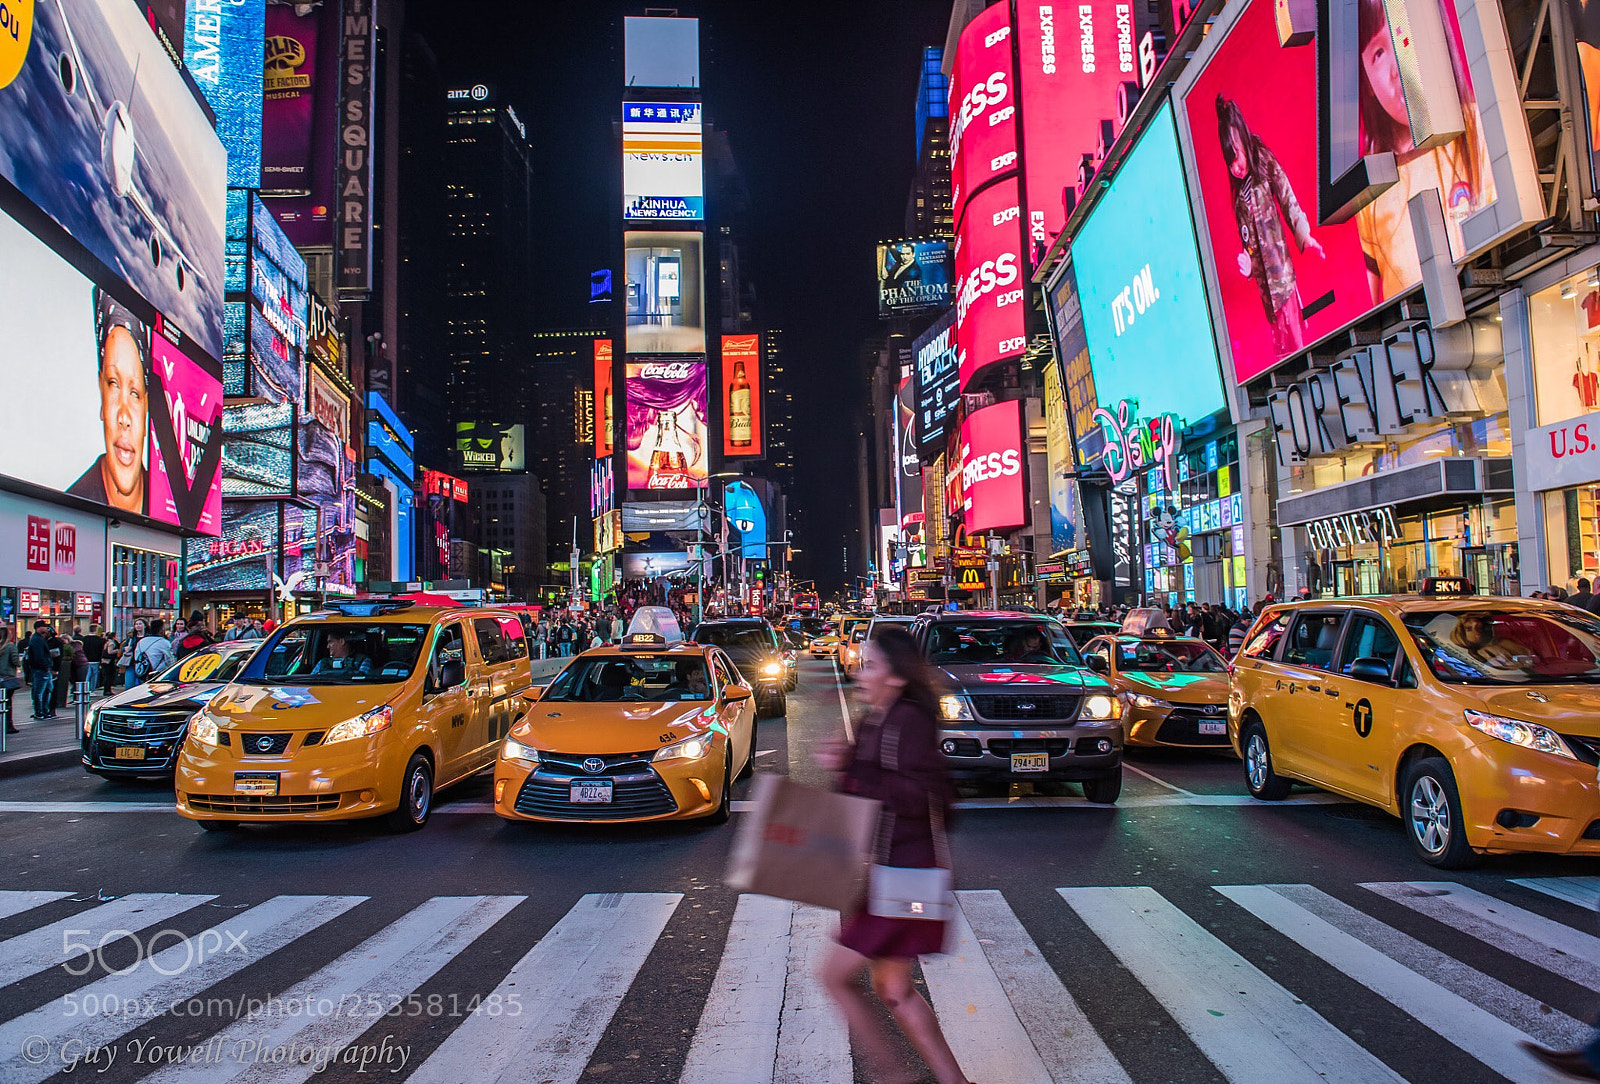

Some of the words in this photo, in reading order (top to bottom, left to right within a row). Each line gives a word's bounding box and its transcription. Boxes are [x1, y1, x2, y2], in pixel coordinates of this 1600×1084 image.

[1039, 5, 1056, 75] EXPRESS
[1079, 4, 1096, 73] EXPRESS
[1116, 4, 1133, 73] EXPRESS
[266, 91, 300, 100] MUSICAL
[343, 101, 368, 250] SQUARE
[641, 200, 687, 209] XINHUA
[344, 267, 361, 275] NYC
[881, 283, 948, 300] PHANTOM
[916, 294, 943, 302] OPERA
[641, 363, 689, 379] Coca-Cola
[921, 344, 958, 386] BLACK
[1267, 320, 1449, 466] FOREVER
[1549, 423, 1597, 458] U.S.
[1305, 511, 1376, 551] FOREVER
[1377, 507, 1398, 541] 21
[57, 529, 73, 547] UNI
[209, 540, 263, 555] #ICAN
[1435, 581, 1461, 591] 5K14
[751, 589, 761, 606] tkts
[633, 634, 655, 642] 4B22
[659, 732, 677, 744] 434
